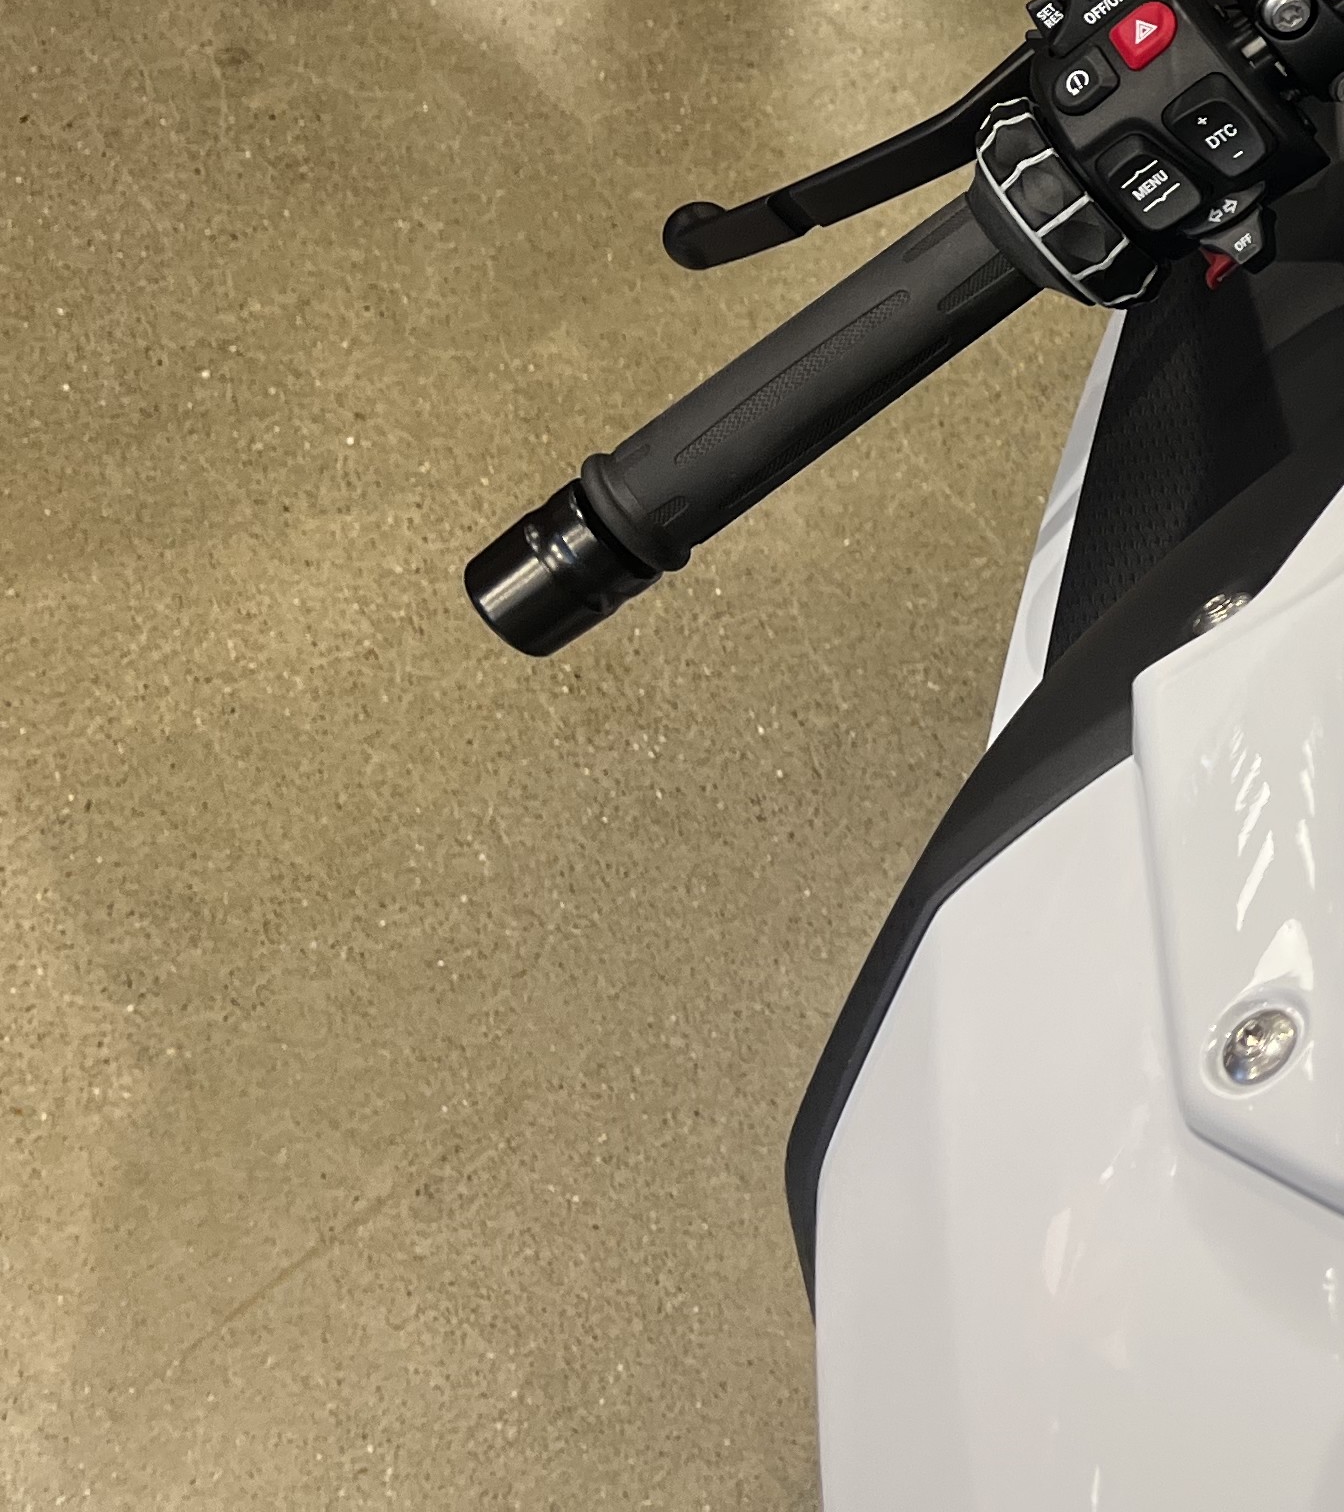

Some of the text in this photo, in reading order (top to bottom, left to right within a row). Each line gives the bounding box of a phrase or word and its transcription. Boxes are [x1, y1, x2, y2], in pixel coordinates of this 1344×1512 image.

[1036, 2, 1056, 21] SET
[1043, 10, 1065, 31] RES
[1204, 123, 1238, 151] DTC
[1131, 169, 1169, 202] MENU
[1234, 233, 1253, 253] OFF
